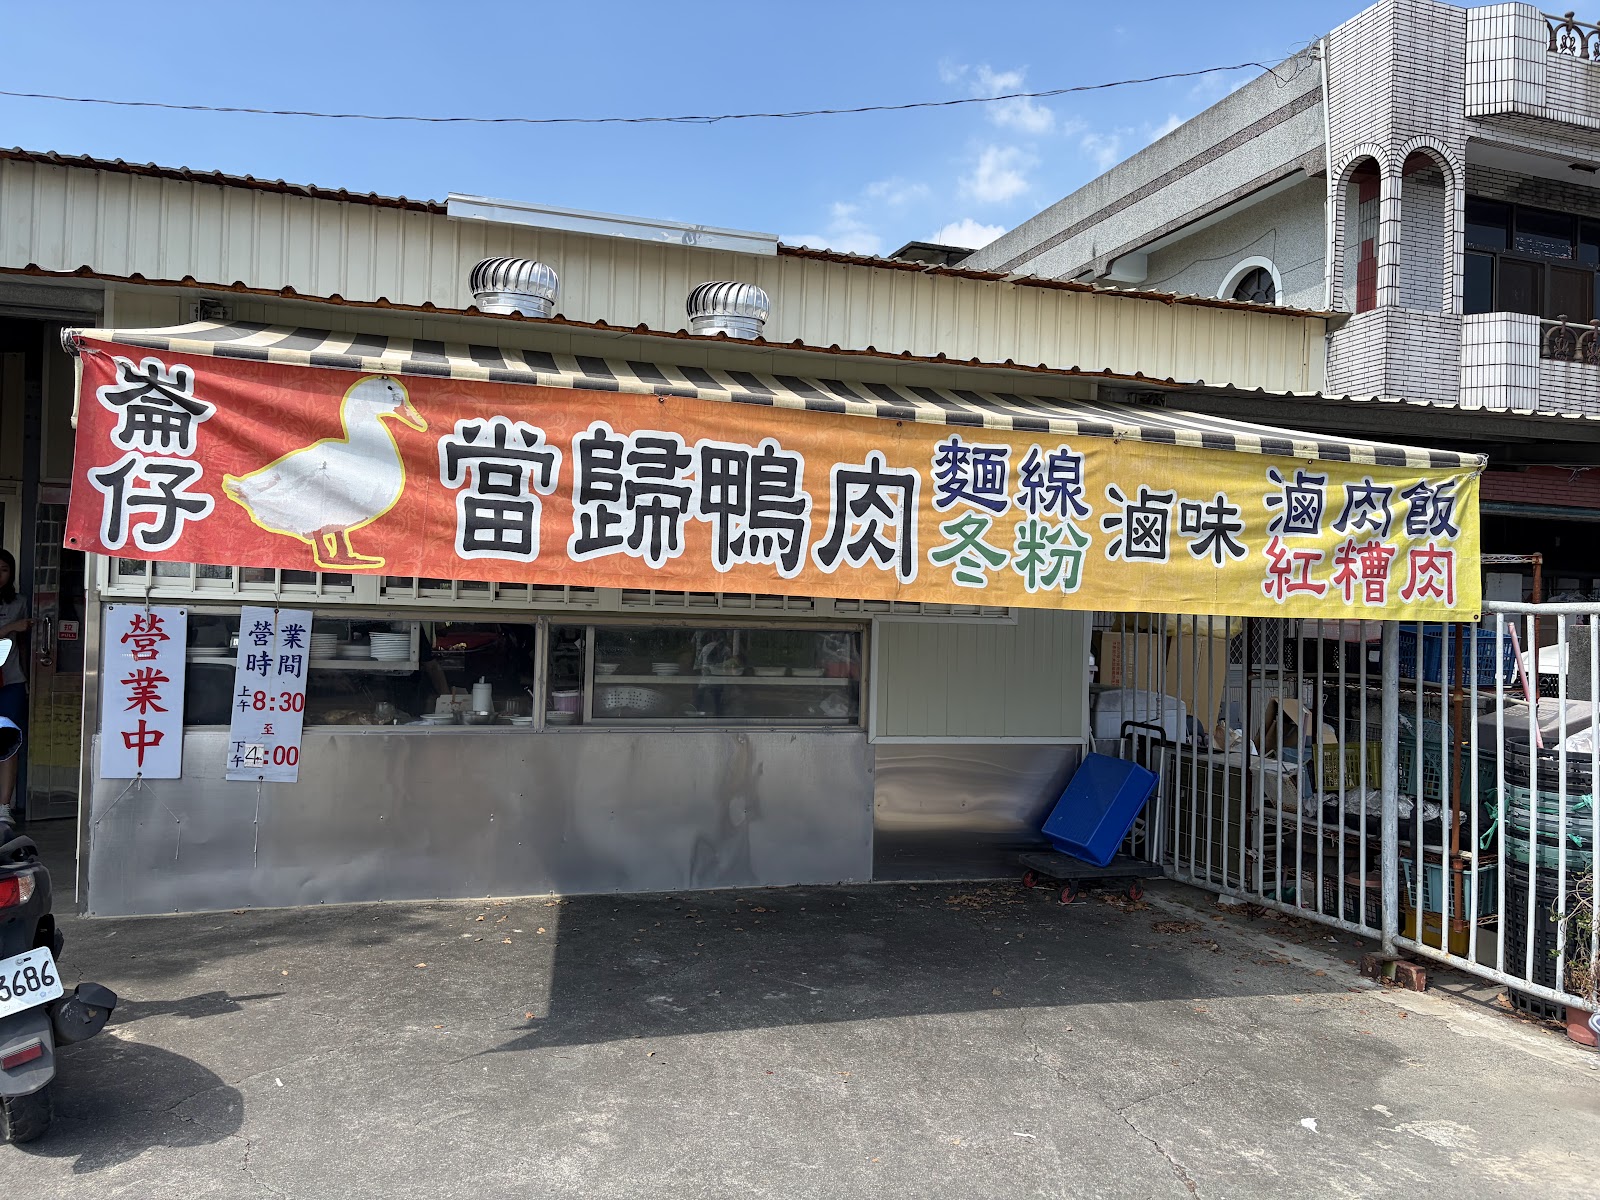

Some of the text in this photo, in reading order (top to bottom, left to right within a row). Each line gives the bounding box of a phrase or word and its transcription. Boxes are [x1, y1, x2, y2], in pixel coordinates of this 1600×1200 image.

[91, 359, 214, 549] 崙仔
[933, 435, 1090, 519] 麵線
[440, 417, 919, 583] 當歸鴨肉
[1101, 483, 1248, 567] 滷味
[1265, 467, 1460, 540] 滷肉飯
[930, 514, 1091, 593] 冬粉
[1263, 535, 1457, 607] 紅糟肉
[246, 650, 303, 679] 時間
[248, 620, 307, 650] 營業
[120, 613, 171, 768] 營業中
[236, 685, 305, 713] 上午 8:30
[230, 740, 299, 768] 下午 4:00
[261, 723, 275, 735] 至
